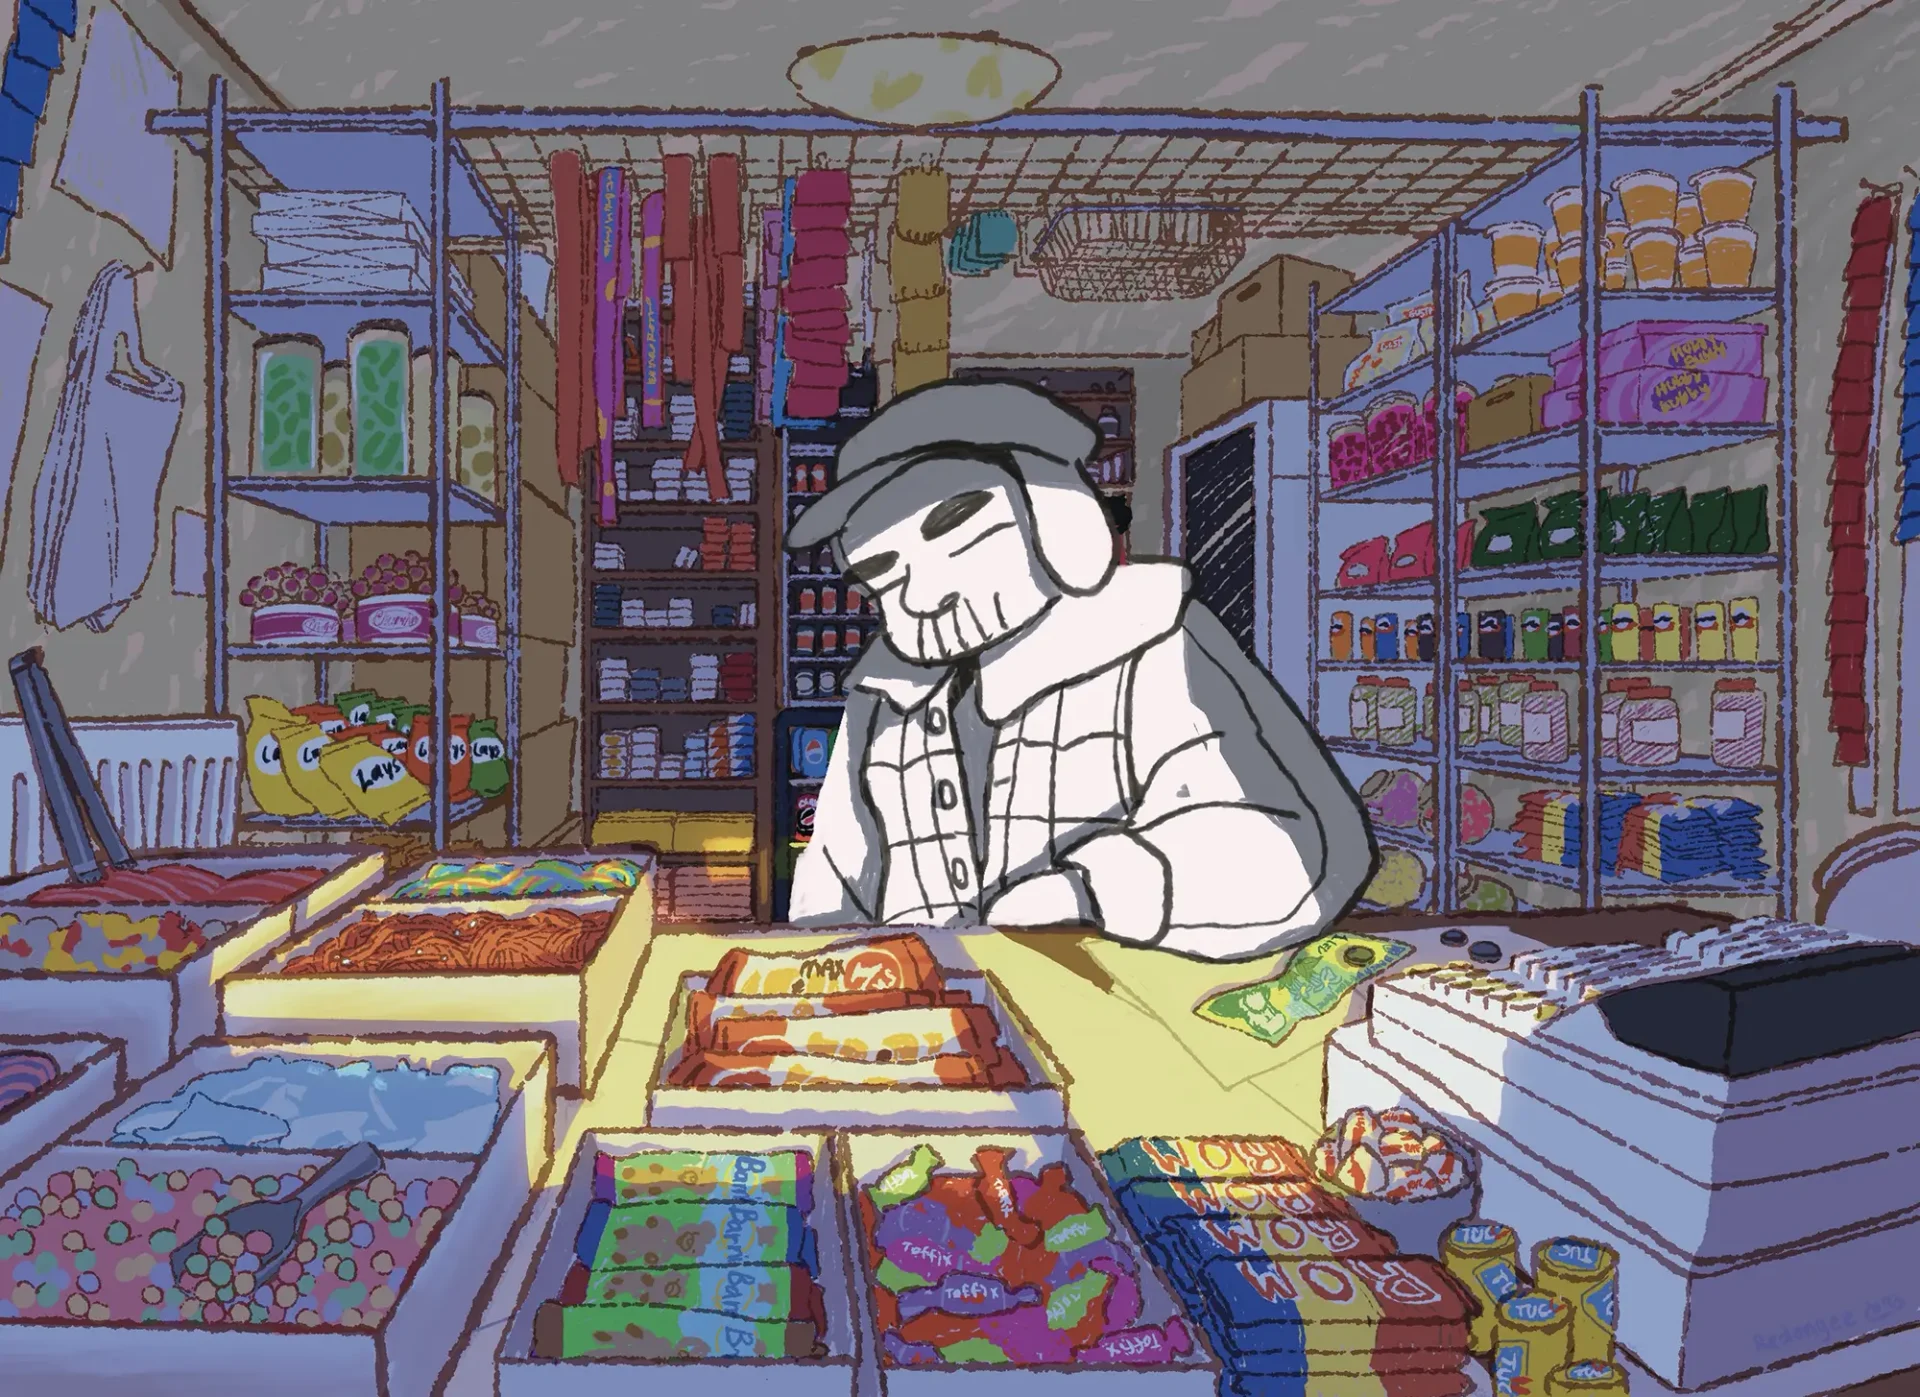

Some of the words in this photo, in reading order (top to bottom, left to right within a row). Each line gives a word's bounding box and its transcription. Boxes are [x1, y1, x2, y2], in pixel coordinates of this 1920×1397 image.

[472, 742, 500, 759] Lays
[355, 759, 402, 794] Lays
[1140, 1137, 1284, 1177] ROM
[1168, 1182, 1314, 1216] ROM
[1199, 1218, 1358, 1255] ROM
[1461, 1226, 1497, 1244] TUC
[901, 1240, 953, 1267] Toffix
[1557, 1243, 1593, 1265] TUC
[944, 1281, 1000, 1301] Toffix
[1234, 1259, 1442, 1305] ROM
[1515, 1302, 1553, 1319] TUC
[1104, 1333, 1162, 1359] Toffix
